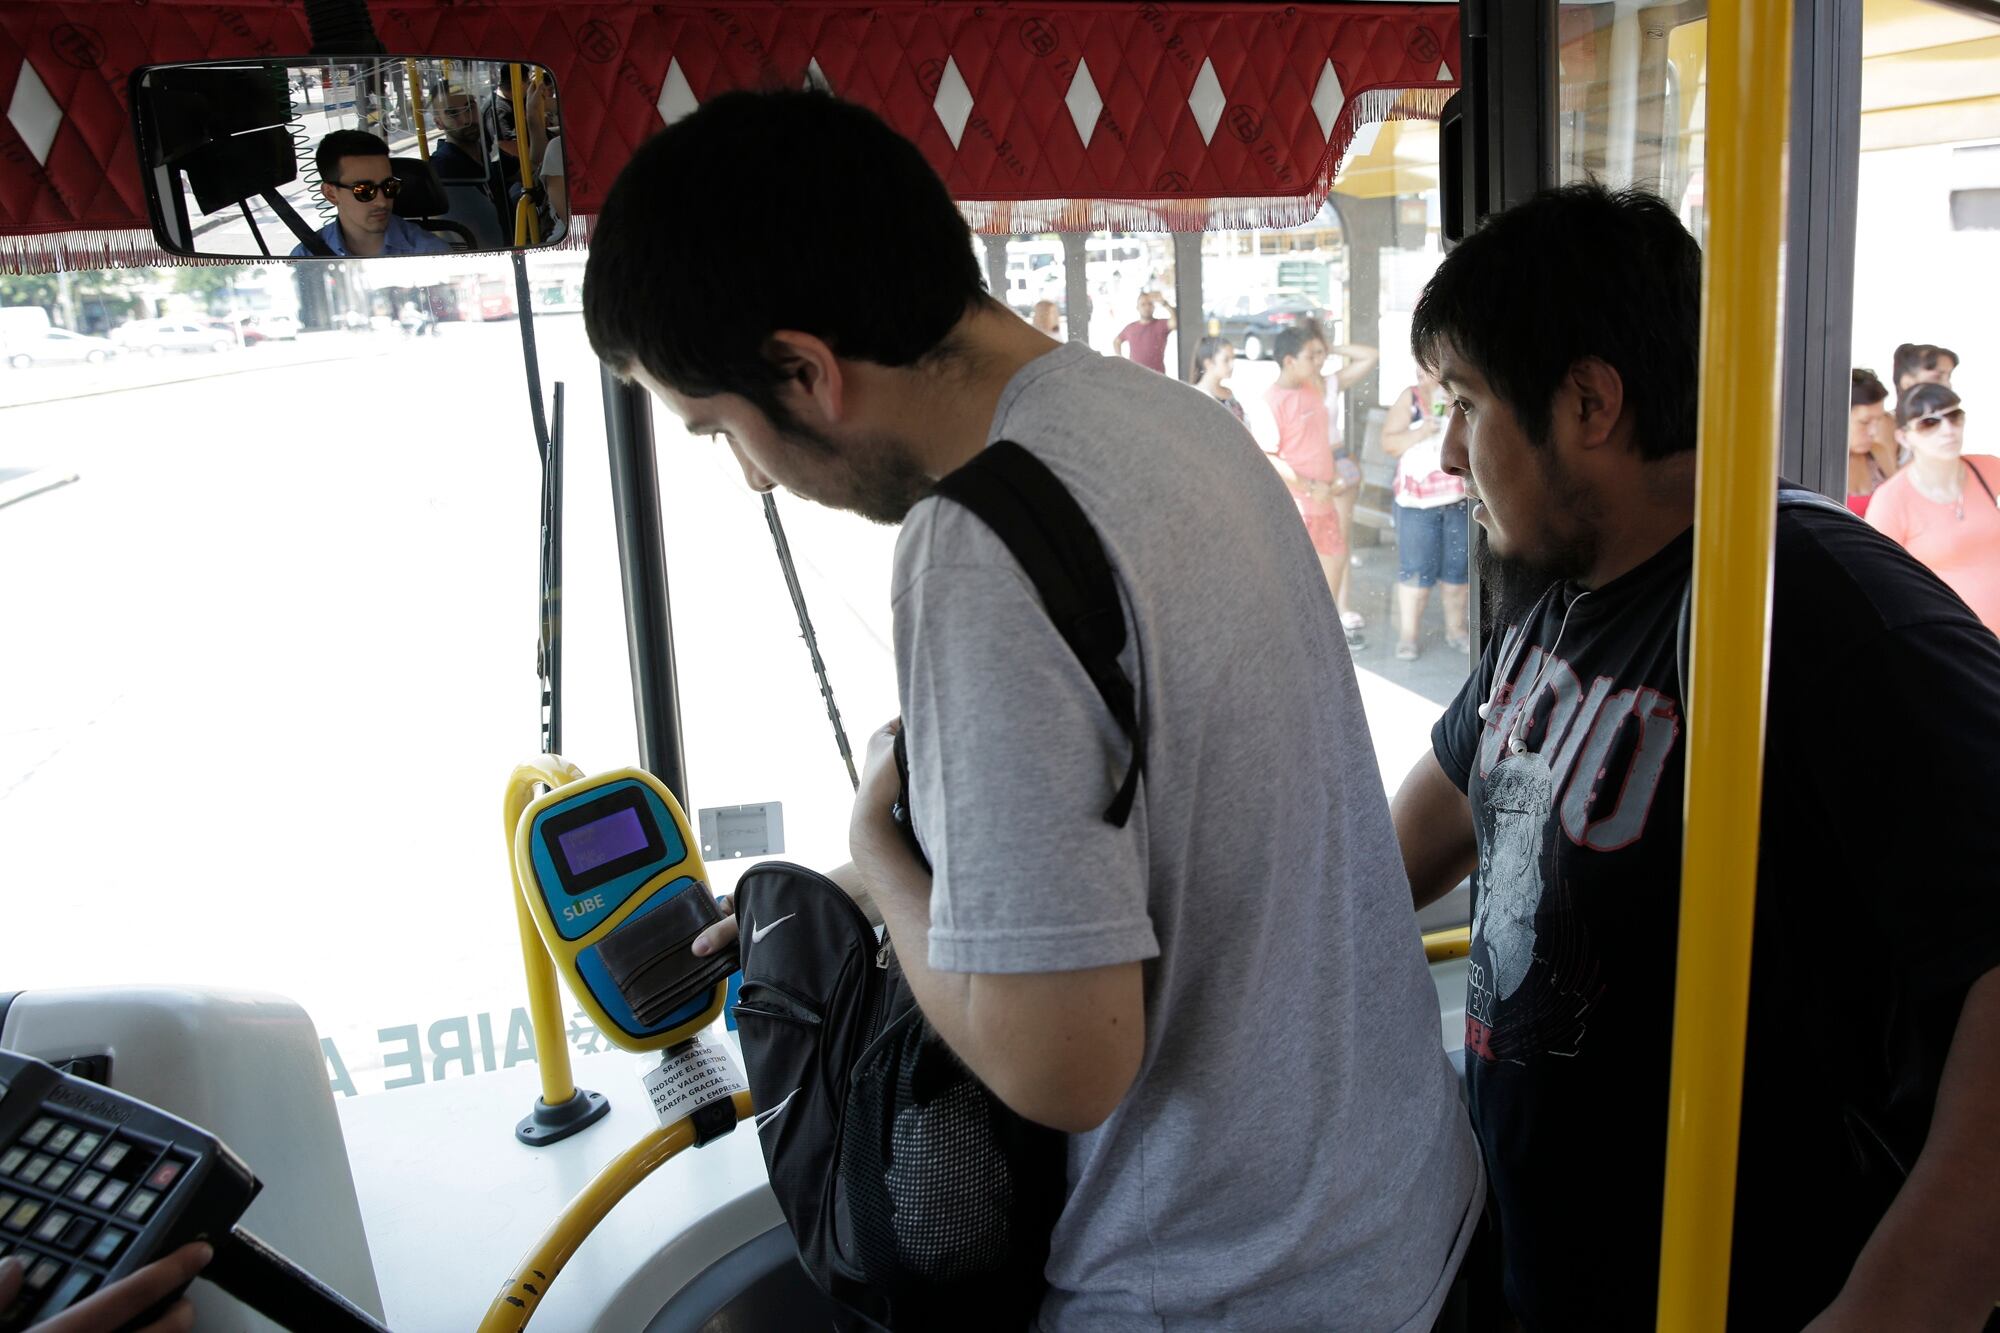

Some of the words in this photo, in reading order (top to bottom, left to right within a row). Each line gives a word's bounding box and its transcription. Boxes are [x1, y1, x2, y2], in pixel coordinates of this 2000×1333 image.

[563, 894, 606, 921] SUBE
[662, 1048, 712, 1075] SR.PASAJERO
[649, 1069, 685, 1096] INDIQUE
[684, 1065, 696, 1074] EL
[697, 1055, 727, 1068] DESTINO
[653, 1094, 666, 1106] NO
[667, 1088, 678, 1097] EL
[677, 1071, 706, 1090] VALOR
[706, 1067, 717, 1076] DE
[657, 1093, 688, 1114] TARIFA
[694, 1096, 706, 1106] LA
[706, 1083, 742, 1100] EMPRESA
